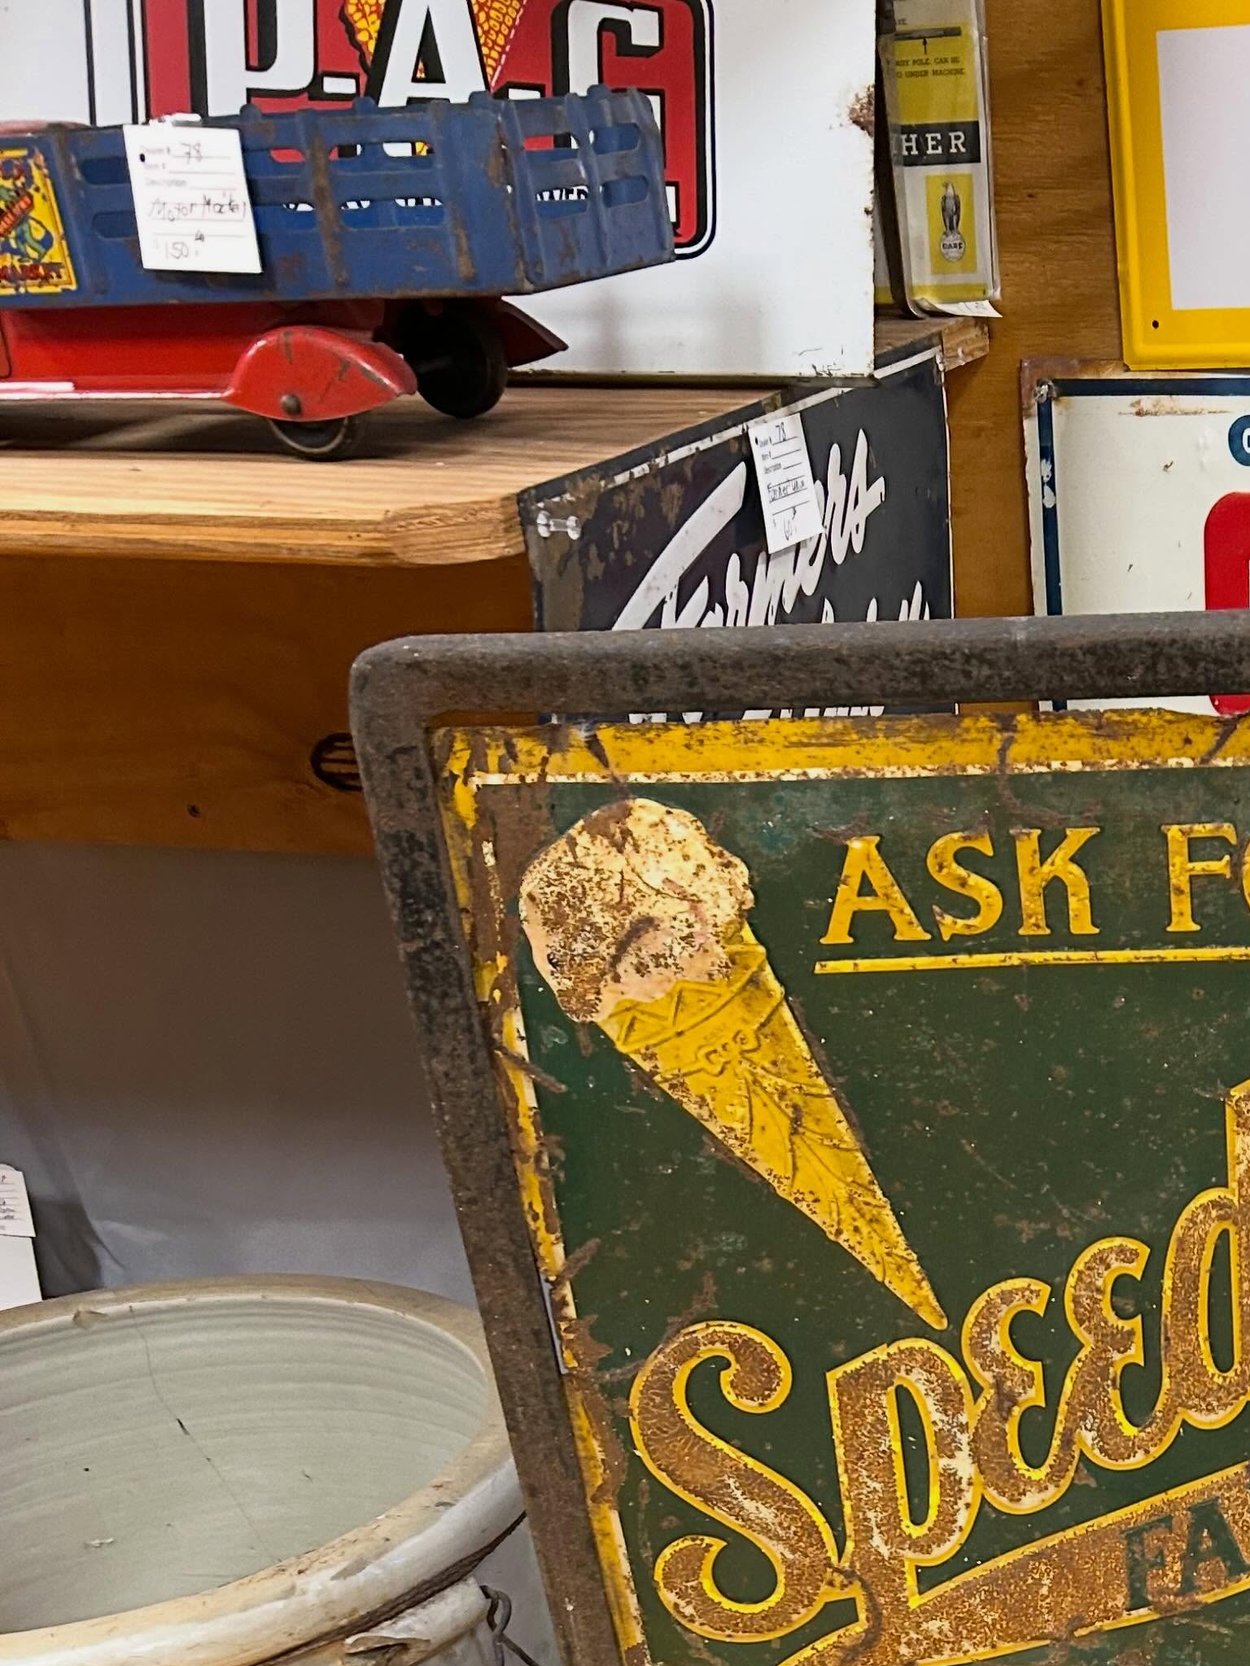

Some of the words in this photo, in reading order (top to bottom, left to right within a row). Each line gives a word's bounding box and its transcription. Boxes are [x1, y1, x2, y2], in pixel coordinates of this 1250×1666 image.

[180, 143, 203, 163] 78
[774, 421, 787, 442] 78
[819, 827, 1101, 945] ASK
